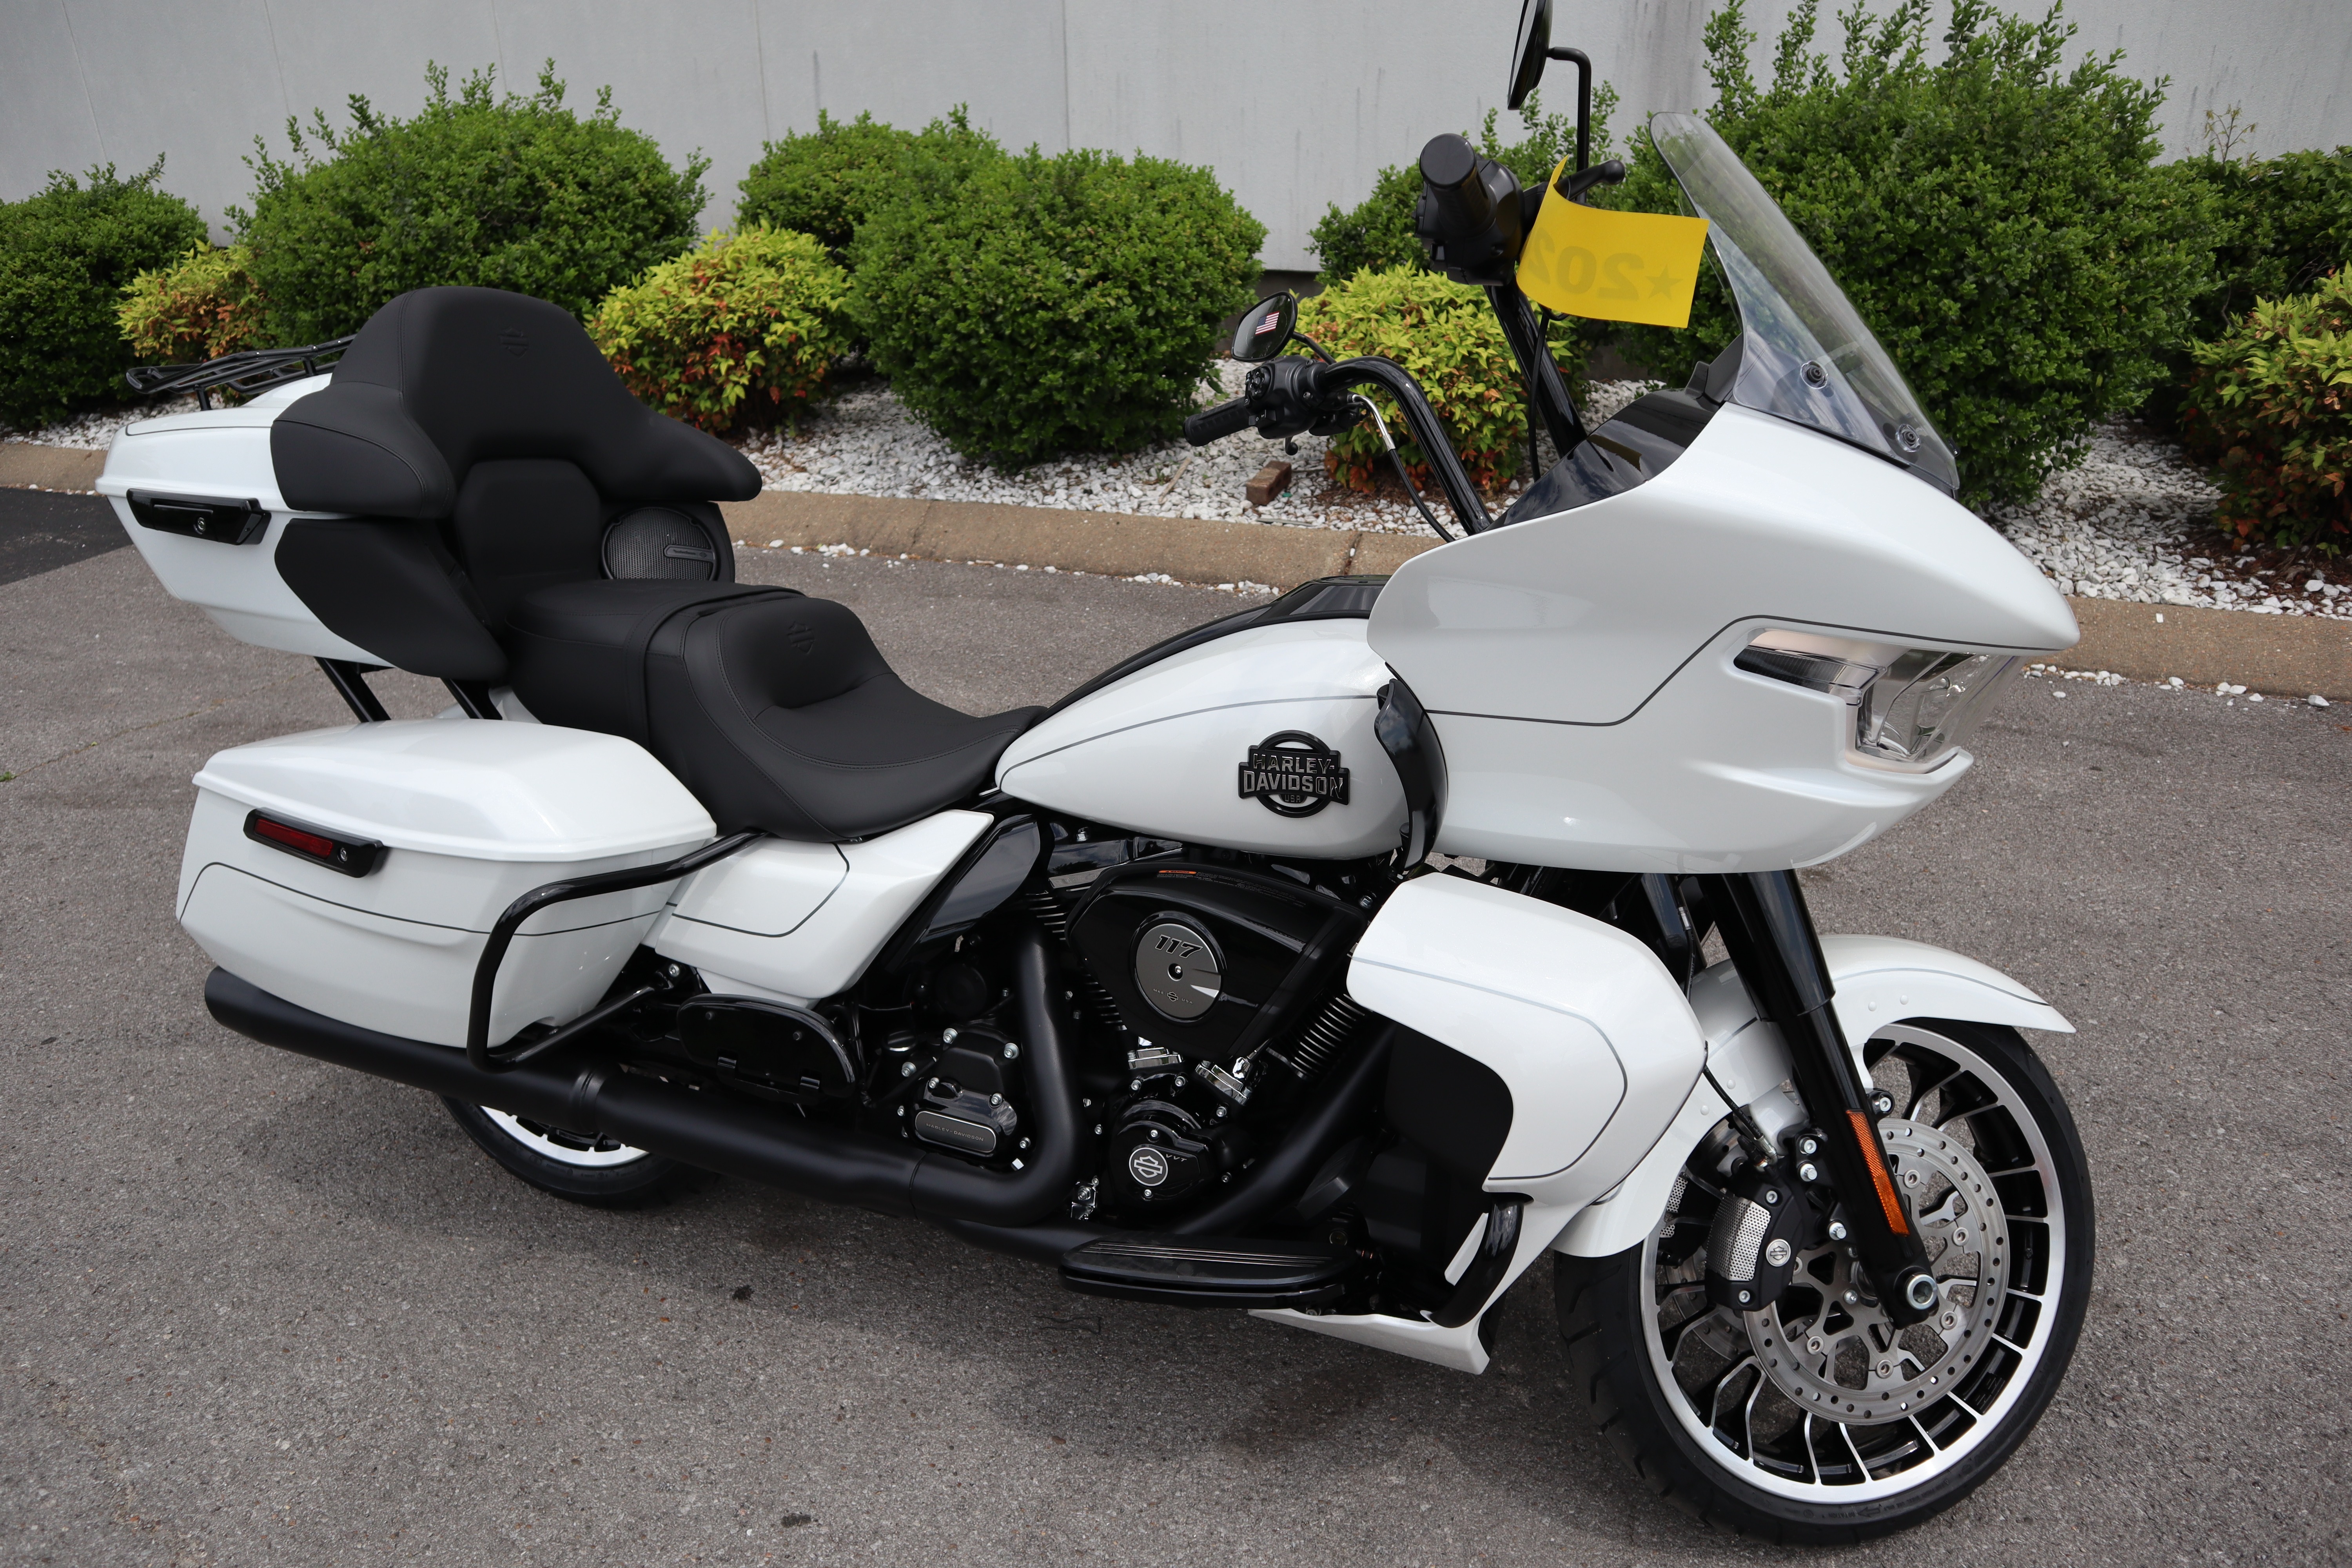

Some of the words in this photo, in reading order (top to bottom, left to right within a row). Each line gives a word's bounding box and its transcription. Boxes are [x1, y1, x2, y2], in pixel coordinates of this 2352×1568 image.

[1253, 753, 1335, 774] HARLEY-
[1243, 770, 1343, 799] DAVIDSON
[1285, 795, 1301, 803] USA
[1154, 934, 1203, 959] 117
[926, 1123, 984, 1142] HARLEY-DAVIDSON
[1166, 1154, 1187, 1162] VVT
